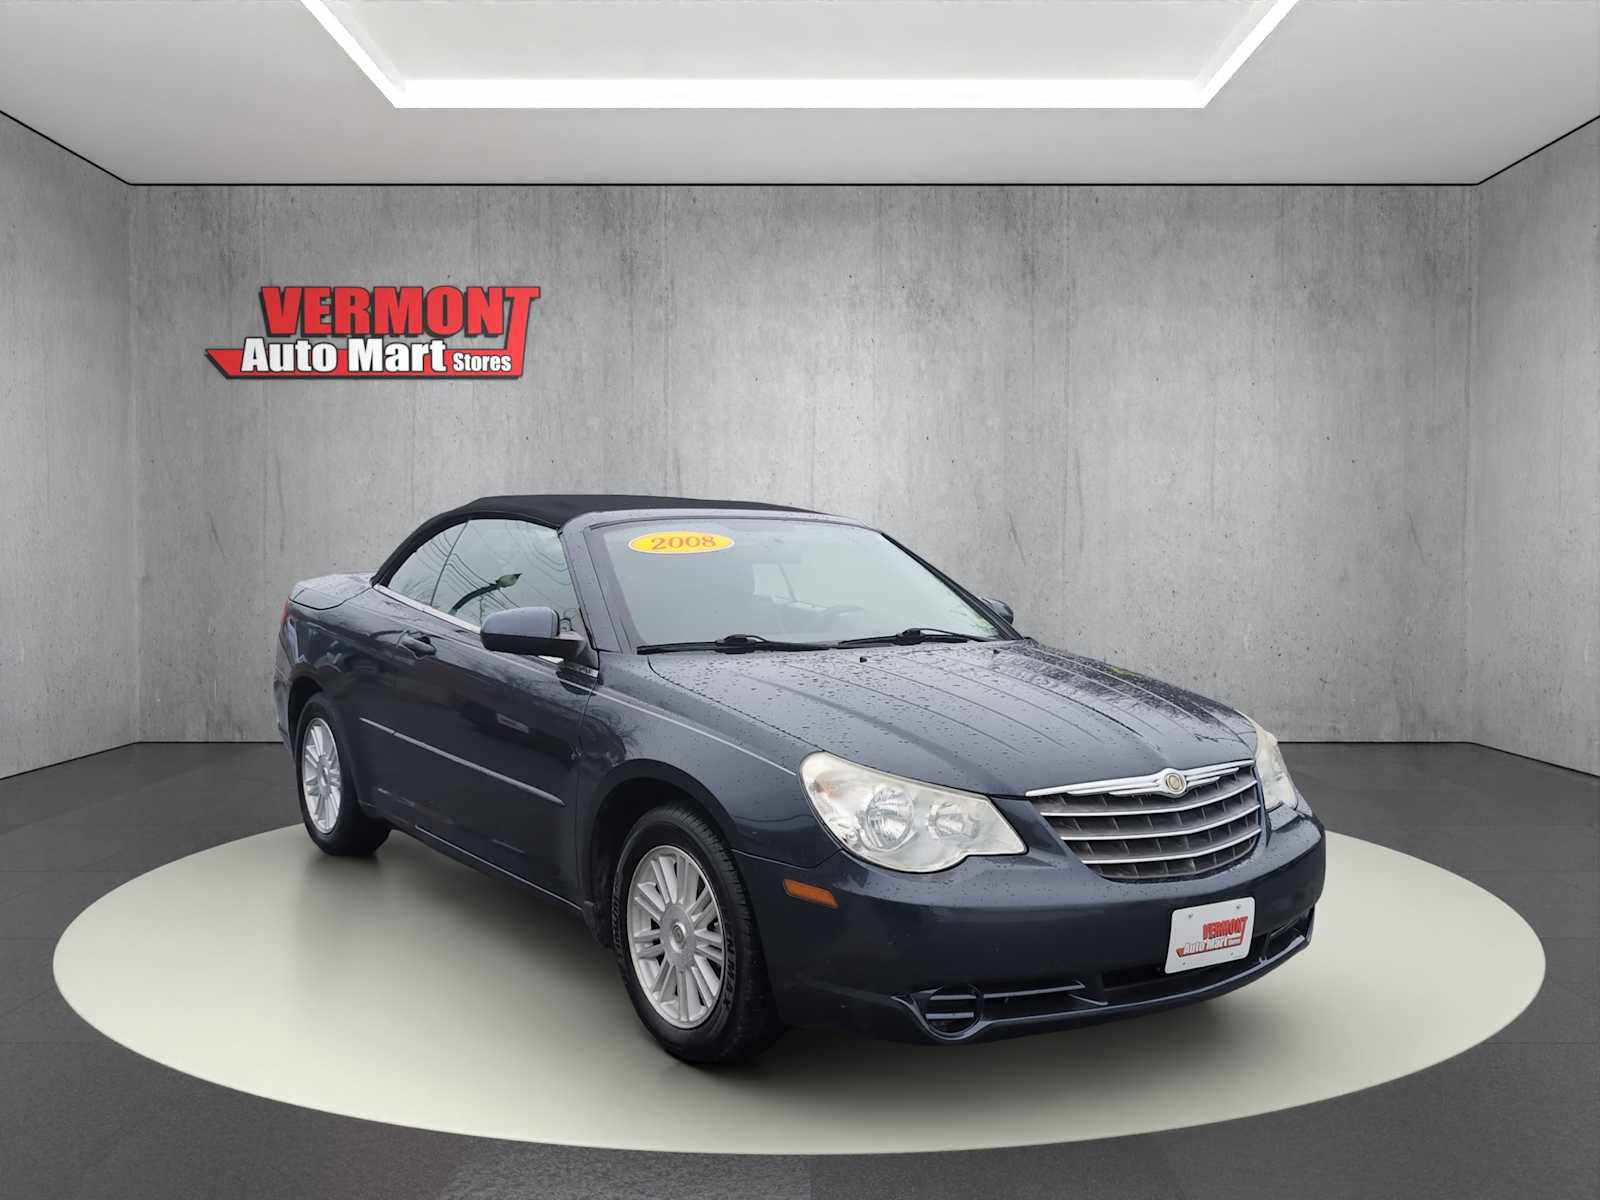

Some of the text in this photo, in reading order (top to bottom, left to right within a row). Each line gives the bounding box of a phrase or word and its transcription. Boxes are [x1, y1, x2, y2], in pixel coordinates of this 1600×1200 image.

[259, 285, 541, 339] VERMONT
[240, 336, 512, 373] Auto Mart Stores
[651, 535, 716, 550] 2008
[1203, 916, 1248, 940] VERMONT
[1184, 941, 1206, 954] Auto
